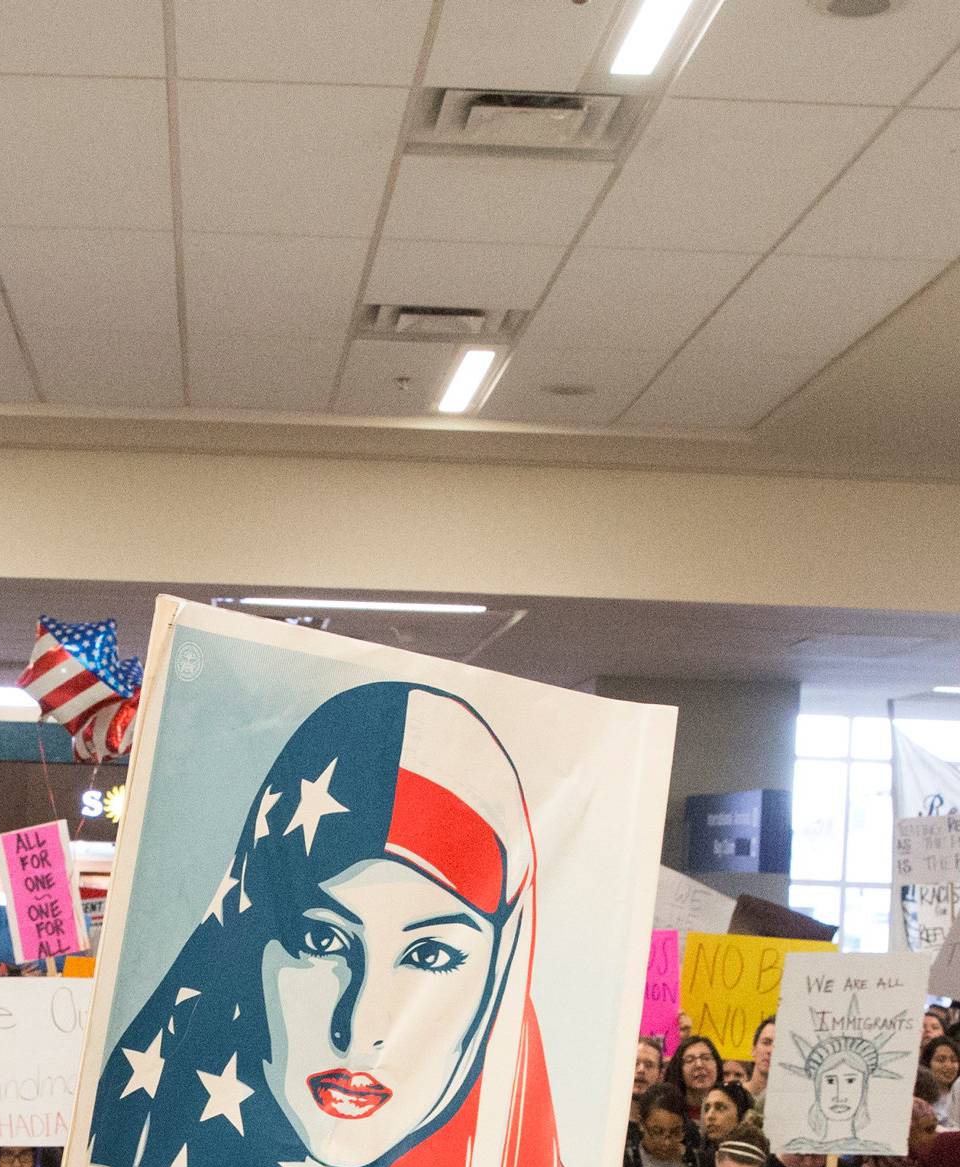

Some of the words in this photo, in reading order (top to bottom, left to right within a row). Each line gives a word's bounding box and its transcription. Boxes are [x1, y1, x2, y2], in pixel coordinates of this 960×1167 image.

[16, 832, 47, 853] ALL
[20, 851, 52, 871] FOR
[24, 873, 55, 893] ONE
[28, 901, 62, 922] ONE
[36, 919, 65, 938] FOR
[38, 940, 71, 959] ALL
[689, 943, 745, 994] NO
[806, 974, 835, 994] WE
[843, 976, 869, 992] ARE
[876, 977, 904, 990] ALL
[698, 1002, 746, 1047] NO
[814, 1009, 914, 1032] IMMIGRANTS
